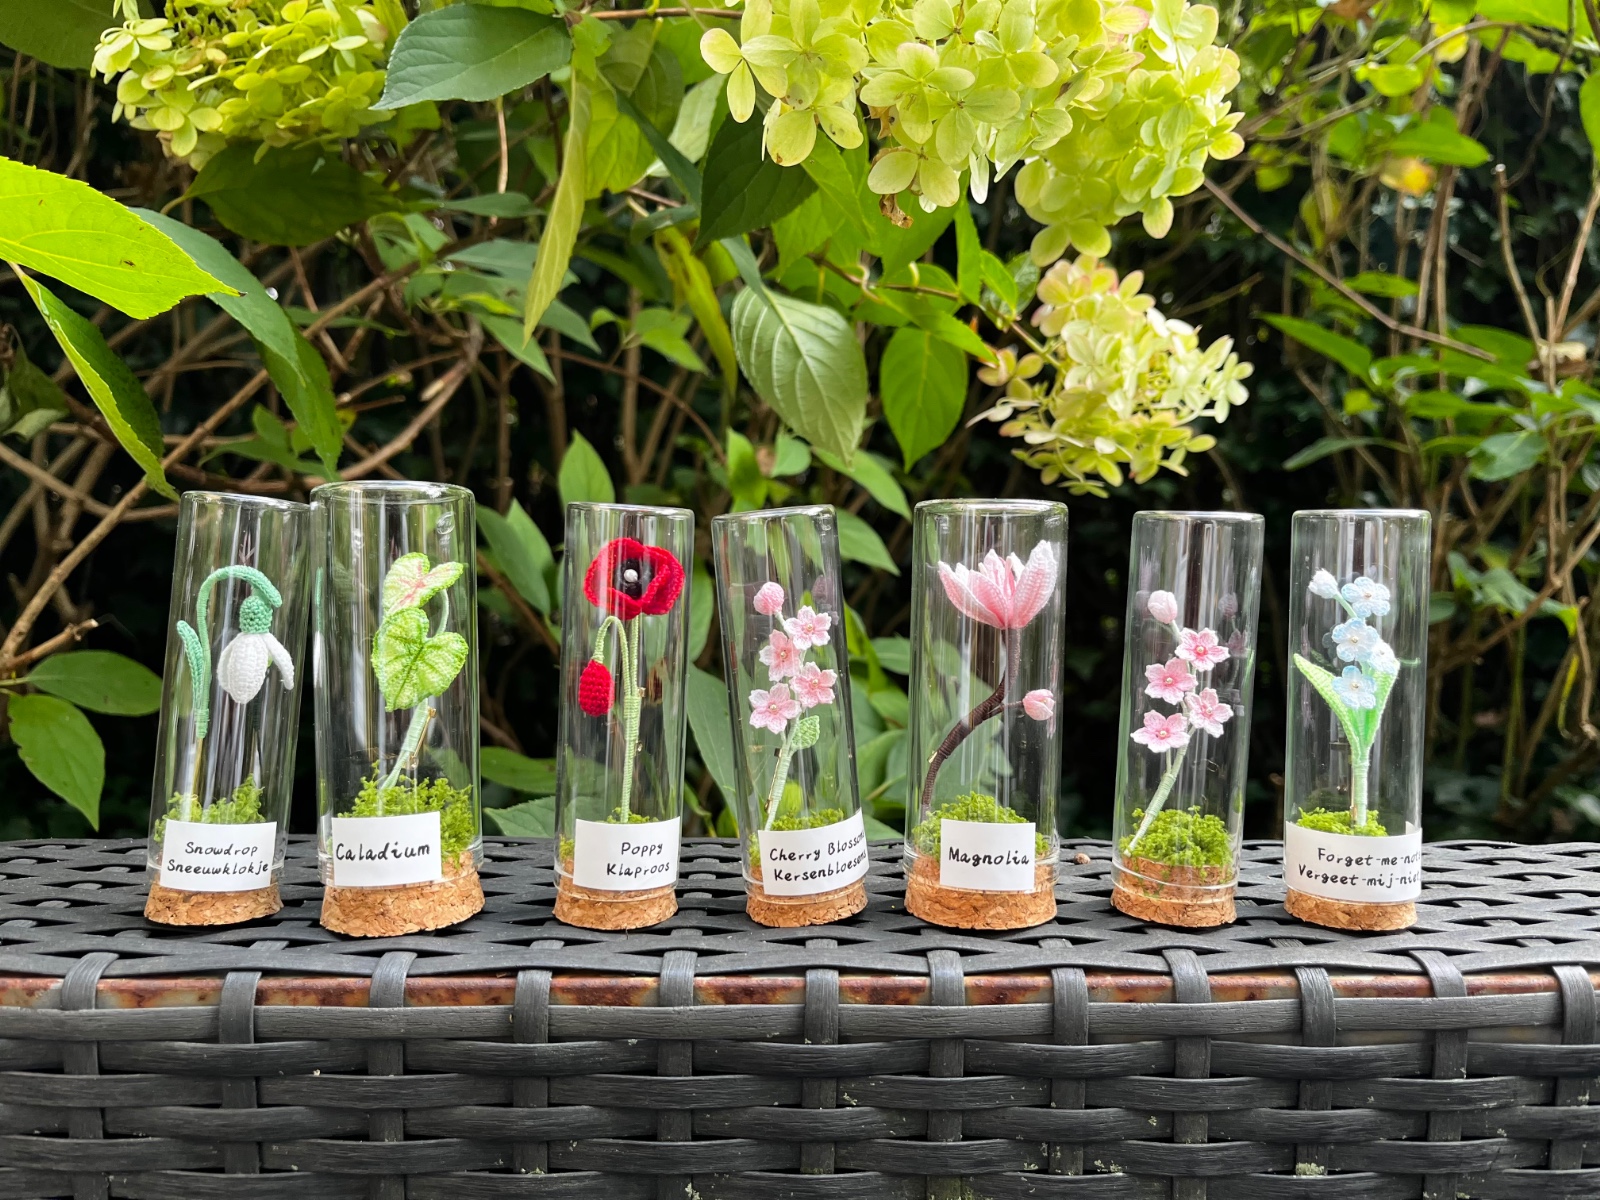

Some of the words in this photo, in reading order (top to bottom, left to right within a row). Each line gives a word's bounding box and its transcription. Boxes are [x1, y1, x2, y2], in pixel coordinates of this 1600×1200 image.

[185, 841, 258, 857] Snowdrop
[335, 841, 430, 861] Caladium
[620, 842, 663, 857] Poppy
[769, 848, 820, 861] Cherry
[948, 846, 1029, 867] Magnolia
[167, 859, 269, 875] Sneeuwklokje
[606, 862, 670, 878] Klaproos
